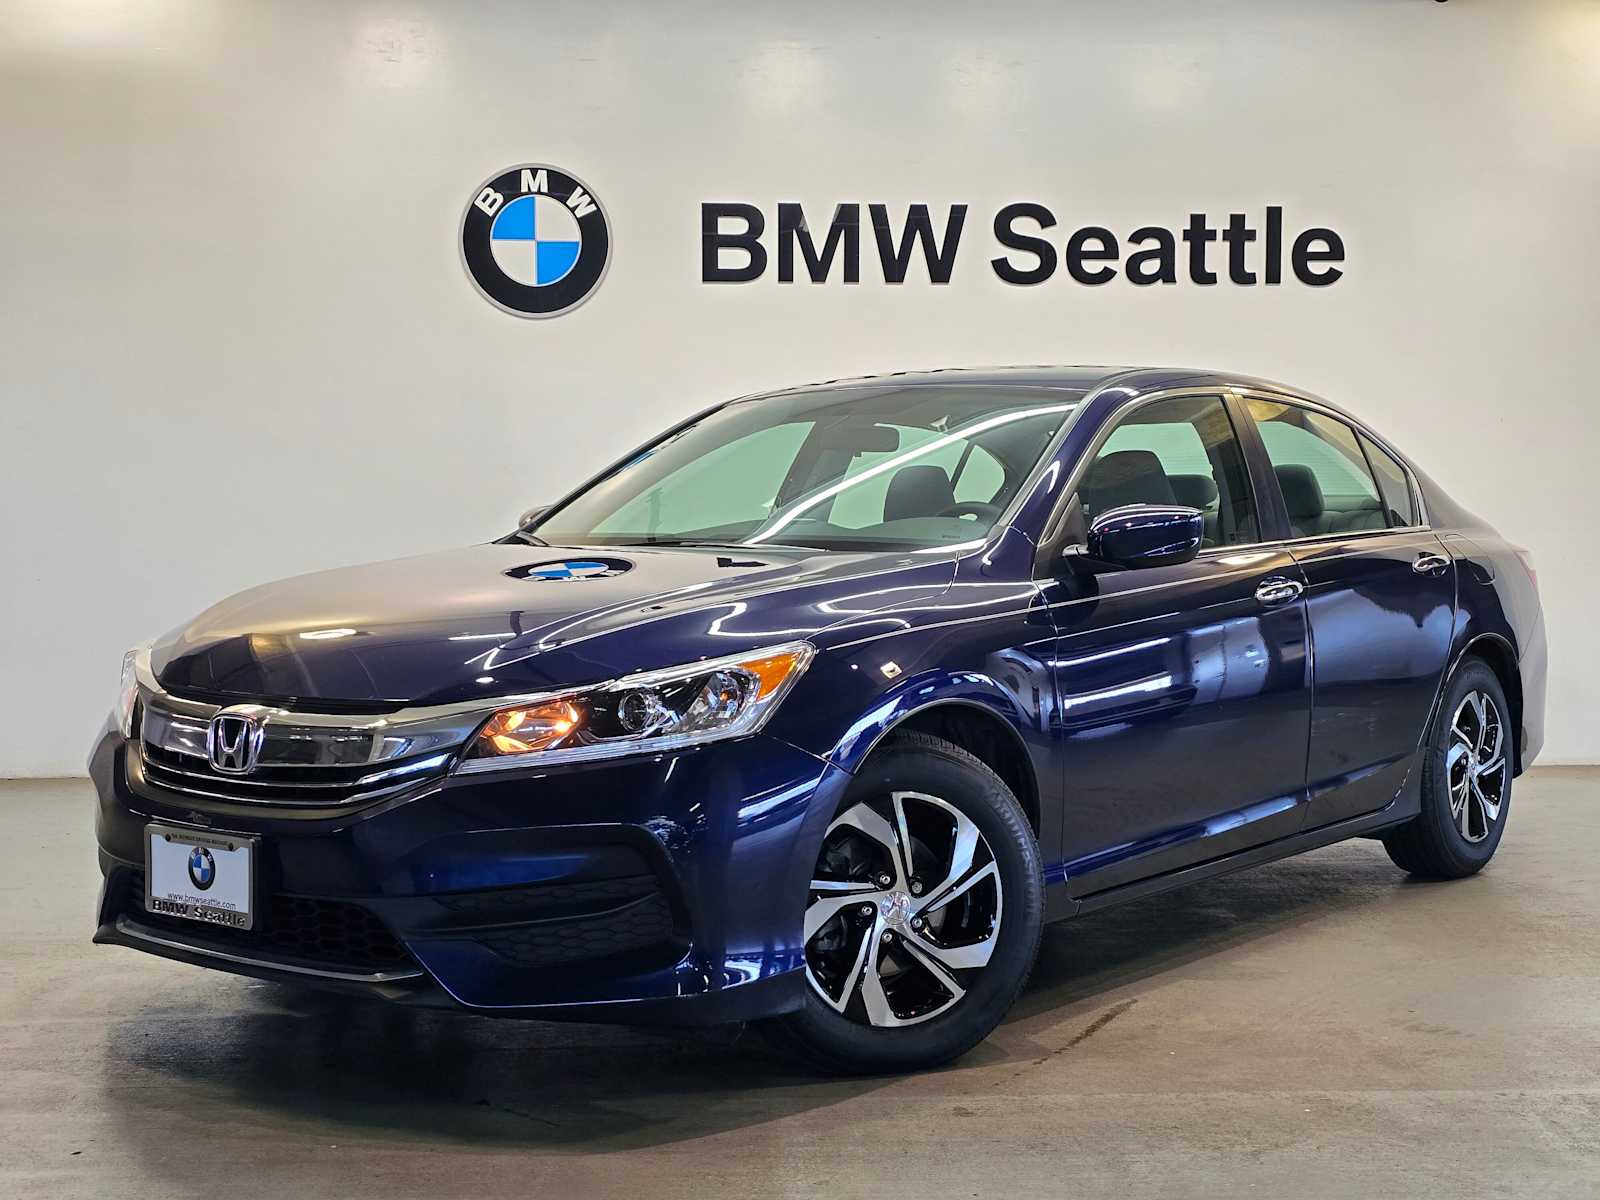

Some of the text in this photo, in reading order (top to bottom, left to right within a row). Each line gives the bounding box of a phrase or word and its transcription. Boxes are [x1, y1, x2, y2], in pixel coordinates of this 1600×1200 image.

[473, 169, 597, 219] BMW
[701, 202, 1346, 286] BMW Seattle
[152, 899, 246, 926] BMW Seattle
